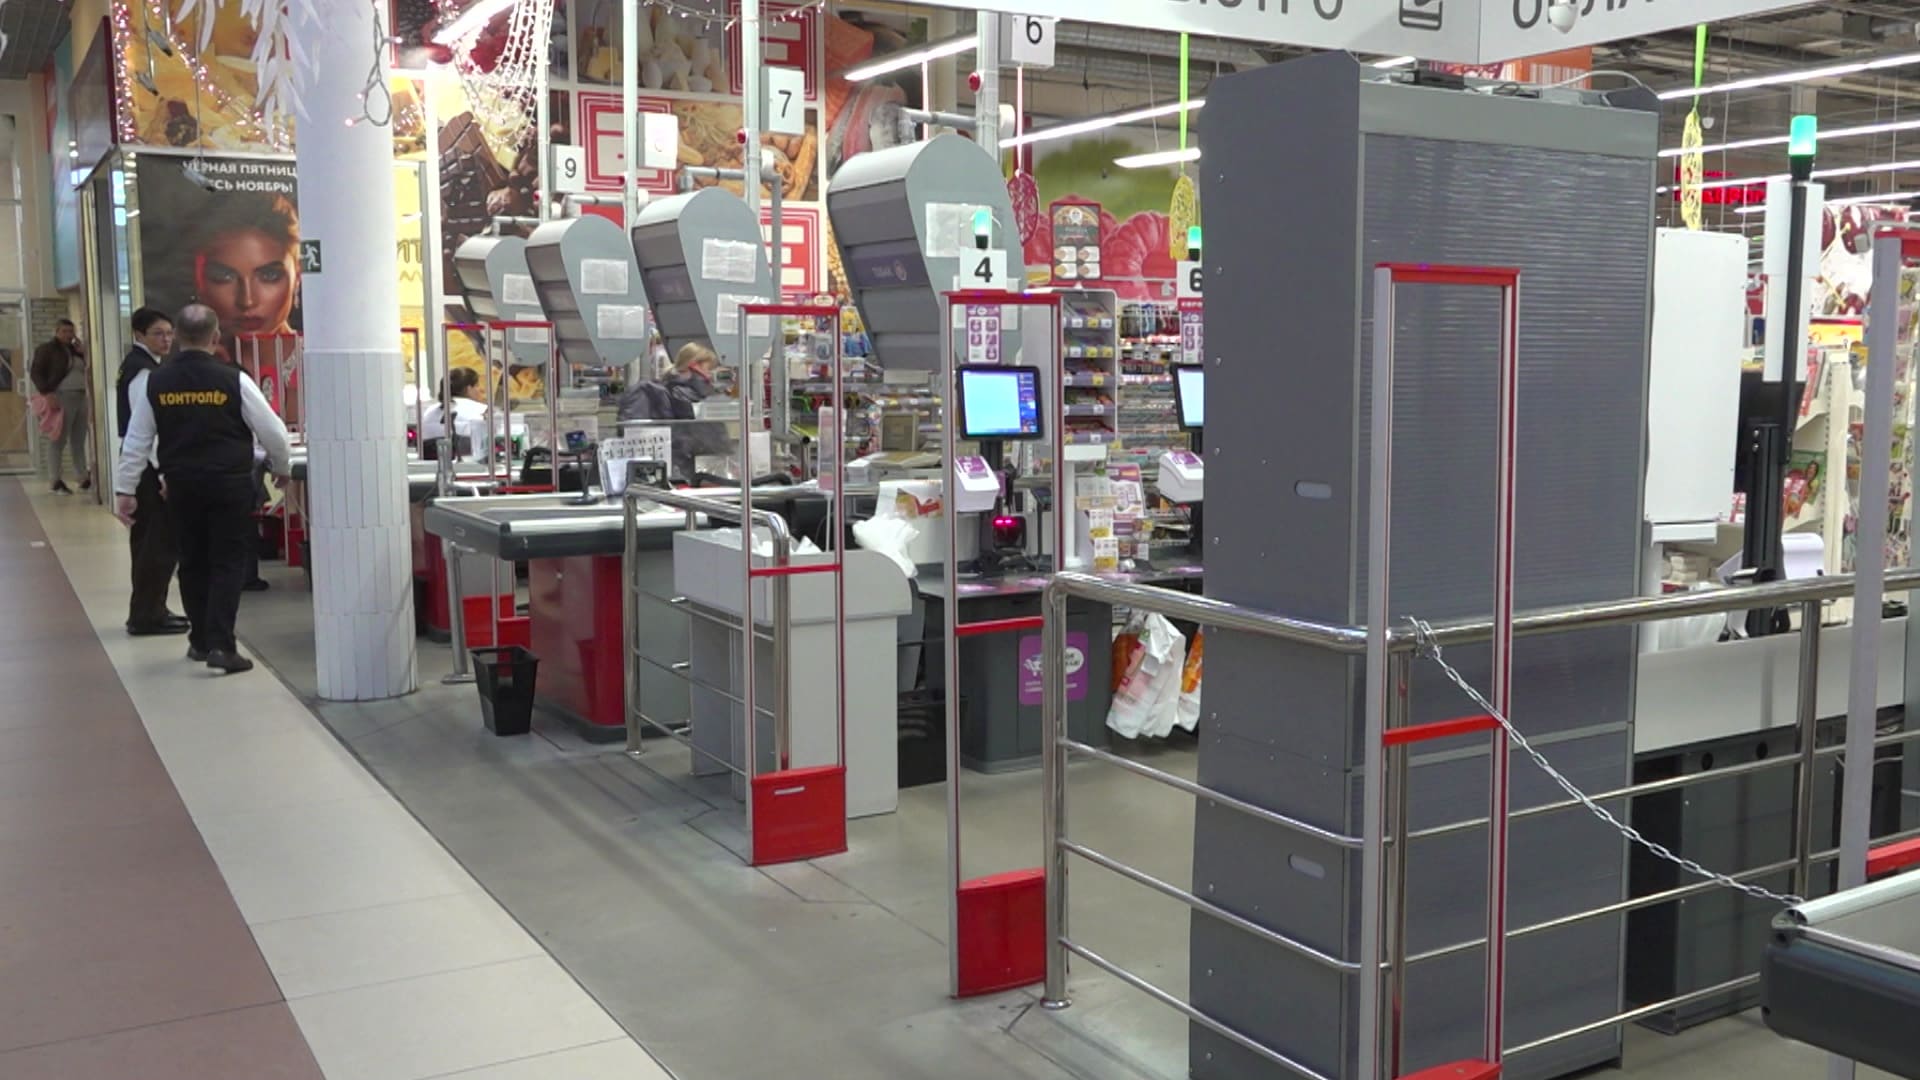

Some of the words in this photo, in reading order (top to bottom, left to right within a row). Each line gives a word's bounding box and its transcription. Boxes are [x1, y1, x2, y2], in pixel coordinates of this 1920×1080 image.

[1026, 15, 1042, 45] 6
[778, 89, 792, 118] 7
[564, 157, 577, 179] 9
[235, 179, 293, 193] НОЯБРЬ!
[974, 256, 993, 283] 4
[159, 389, 228, 406] КОНТРОЛЁР
